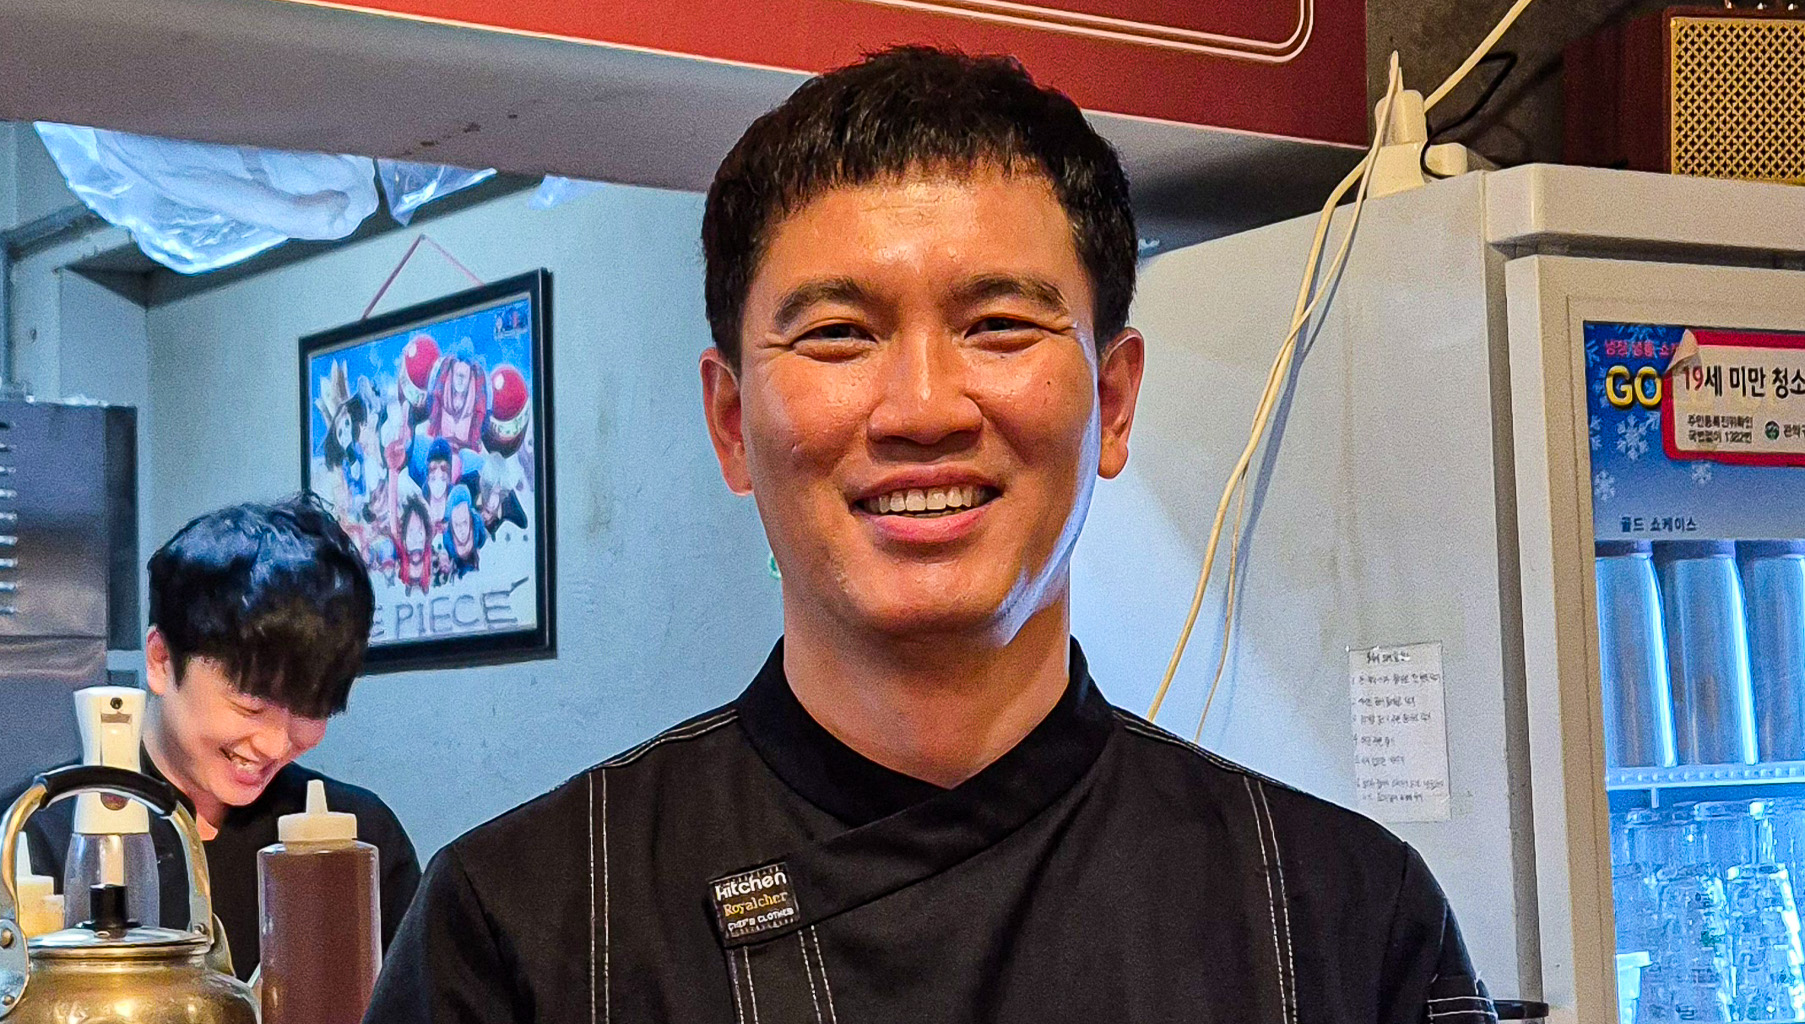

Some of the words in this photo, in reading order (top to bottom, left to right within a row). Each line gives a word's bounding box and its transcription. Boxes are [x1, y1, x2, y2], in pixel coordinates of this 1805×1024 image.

[1683, 365, 1723, 397] 19세
[1729, 365, 1766, 398] 미만
[1621, 516, 1645, 533] 골드
[1650, 516, 1698, 533] 쇼케이스
[395, 578, 528, 640] PIECE
